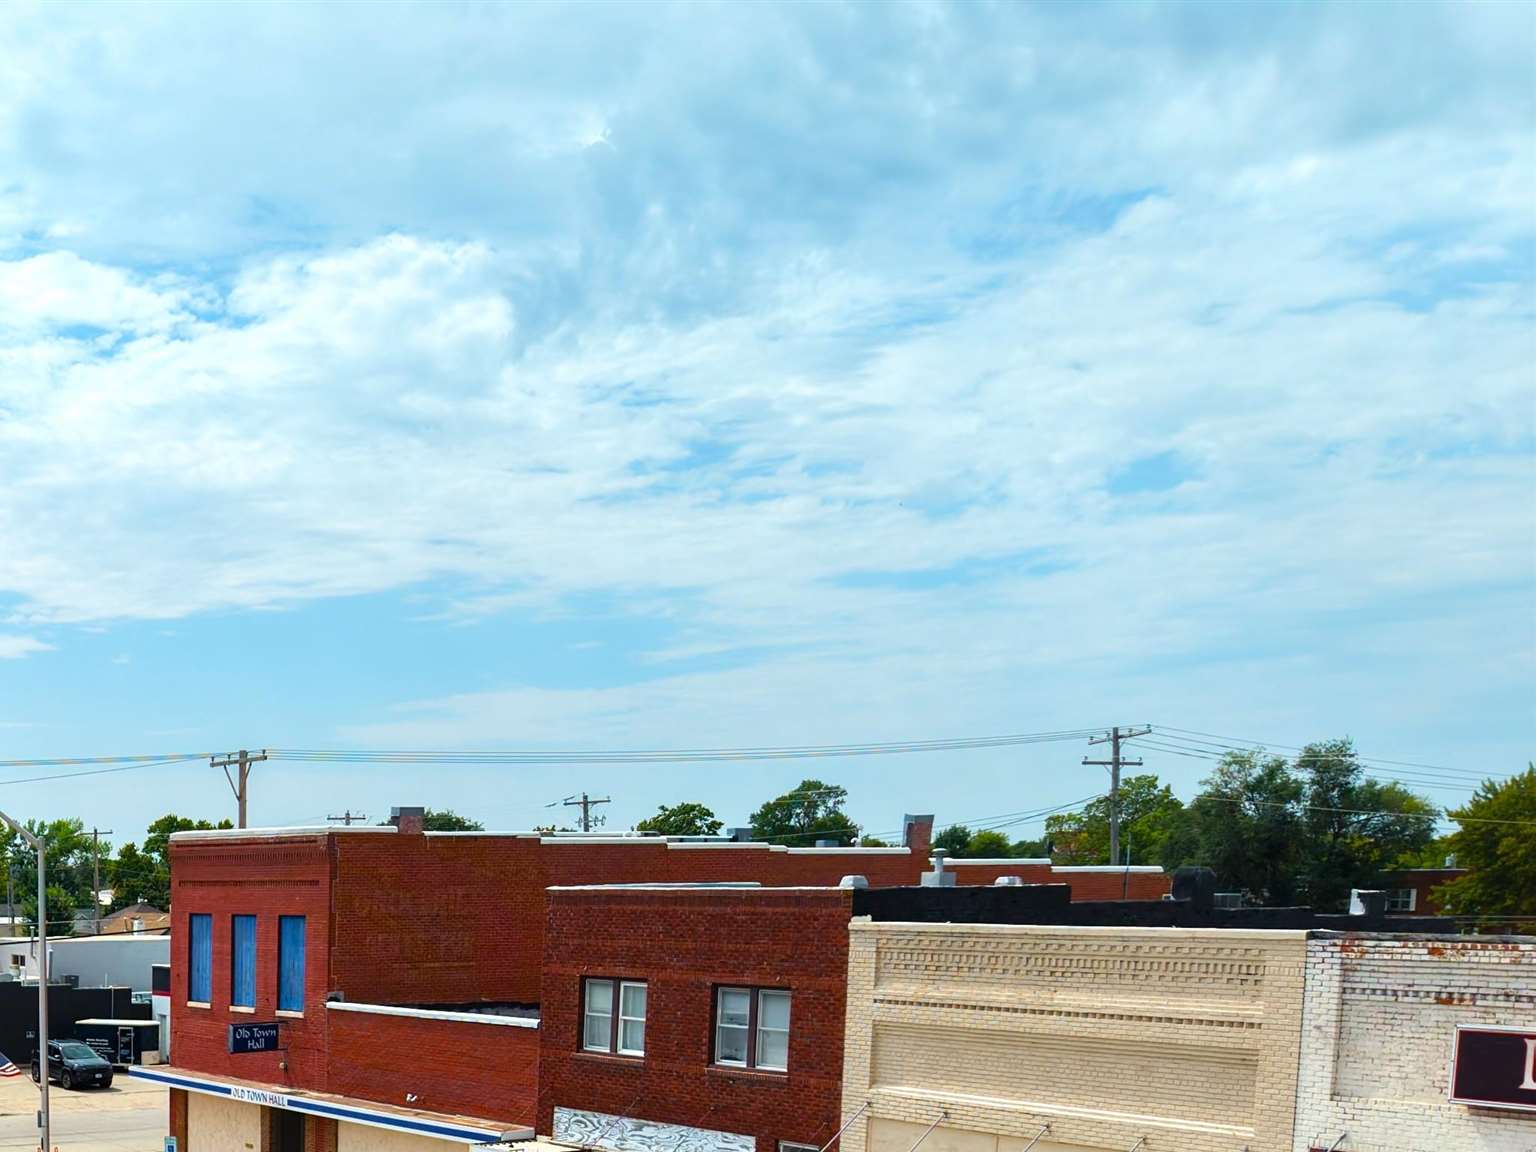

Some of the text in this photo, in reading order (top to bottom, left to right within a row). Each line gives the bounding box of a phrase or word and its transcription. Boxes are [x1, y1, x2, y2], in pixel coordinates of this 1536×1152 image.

[235, 1027, 277, 1039] Old Town
[247, 1038, 265, 1049] Hall
[232, 1088, 286, 1107] OLD TOWN HALL
